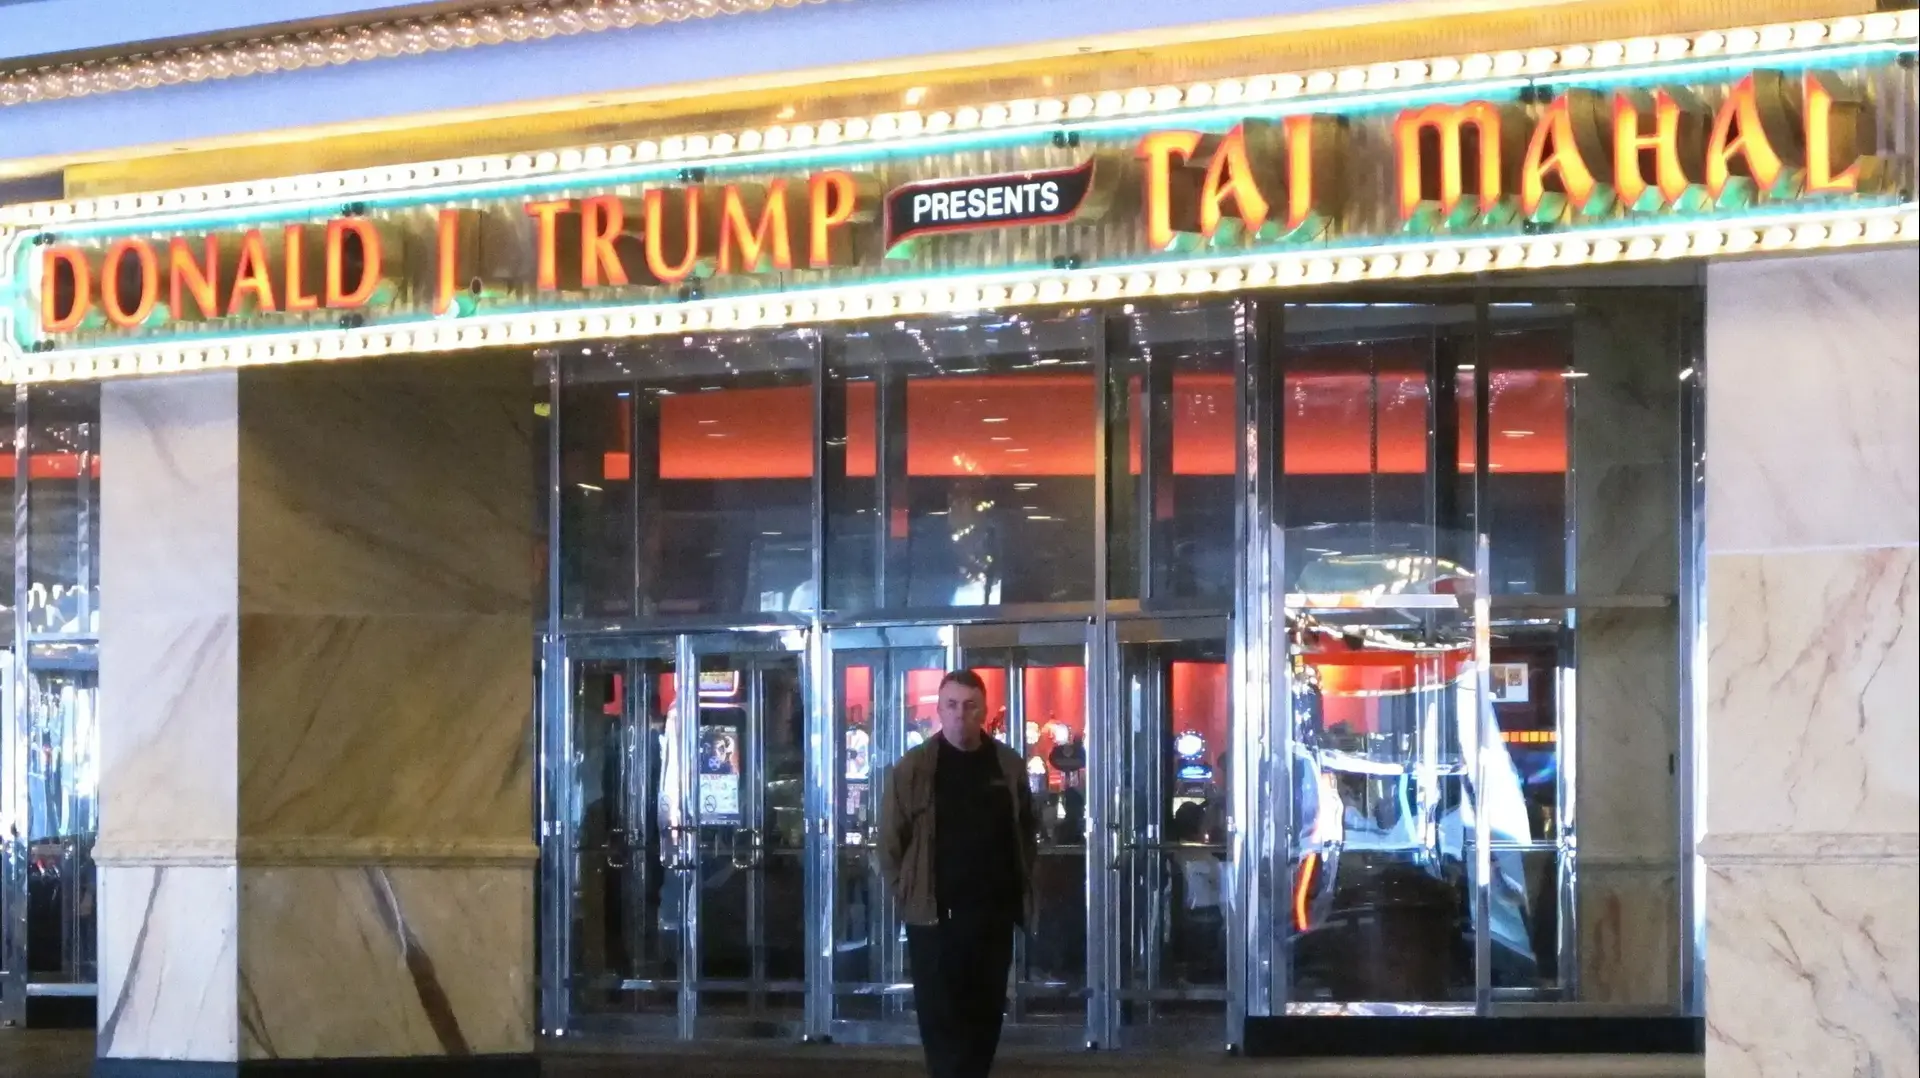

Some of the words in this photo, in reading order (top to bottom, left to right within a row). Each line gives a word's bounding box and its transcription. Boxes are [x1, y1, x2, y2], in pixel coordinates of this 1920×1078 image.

[41, 216, 384, 333] DONALD
[525, 170, 857, 291] TRUMP
[912, 180, 1060, 223] PRESENTS
[1138, 114, 1313, 250] TAJ
[1394, 70, 1861, 216] MAHAL
